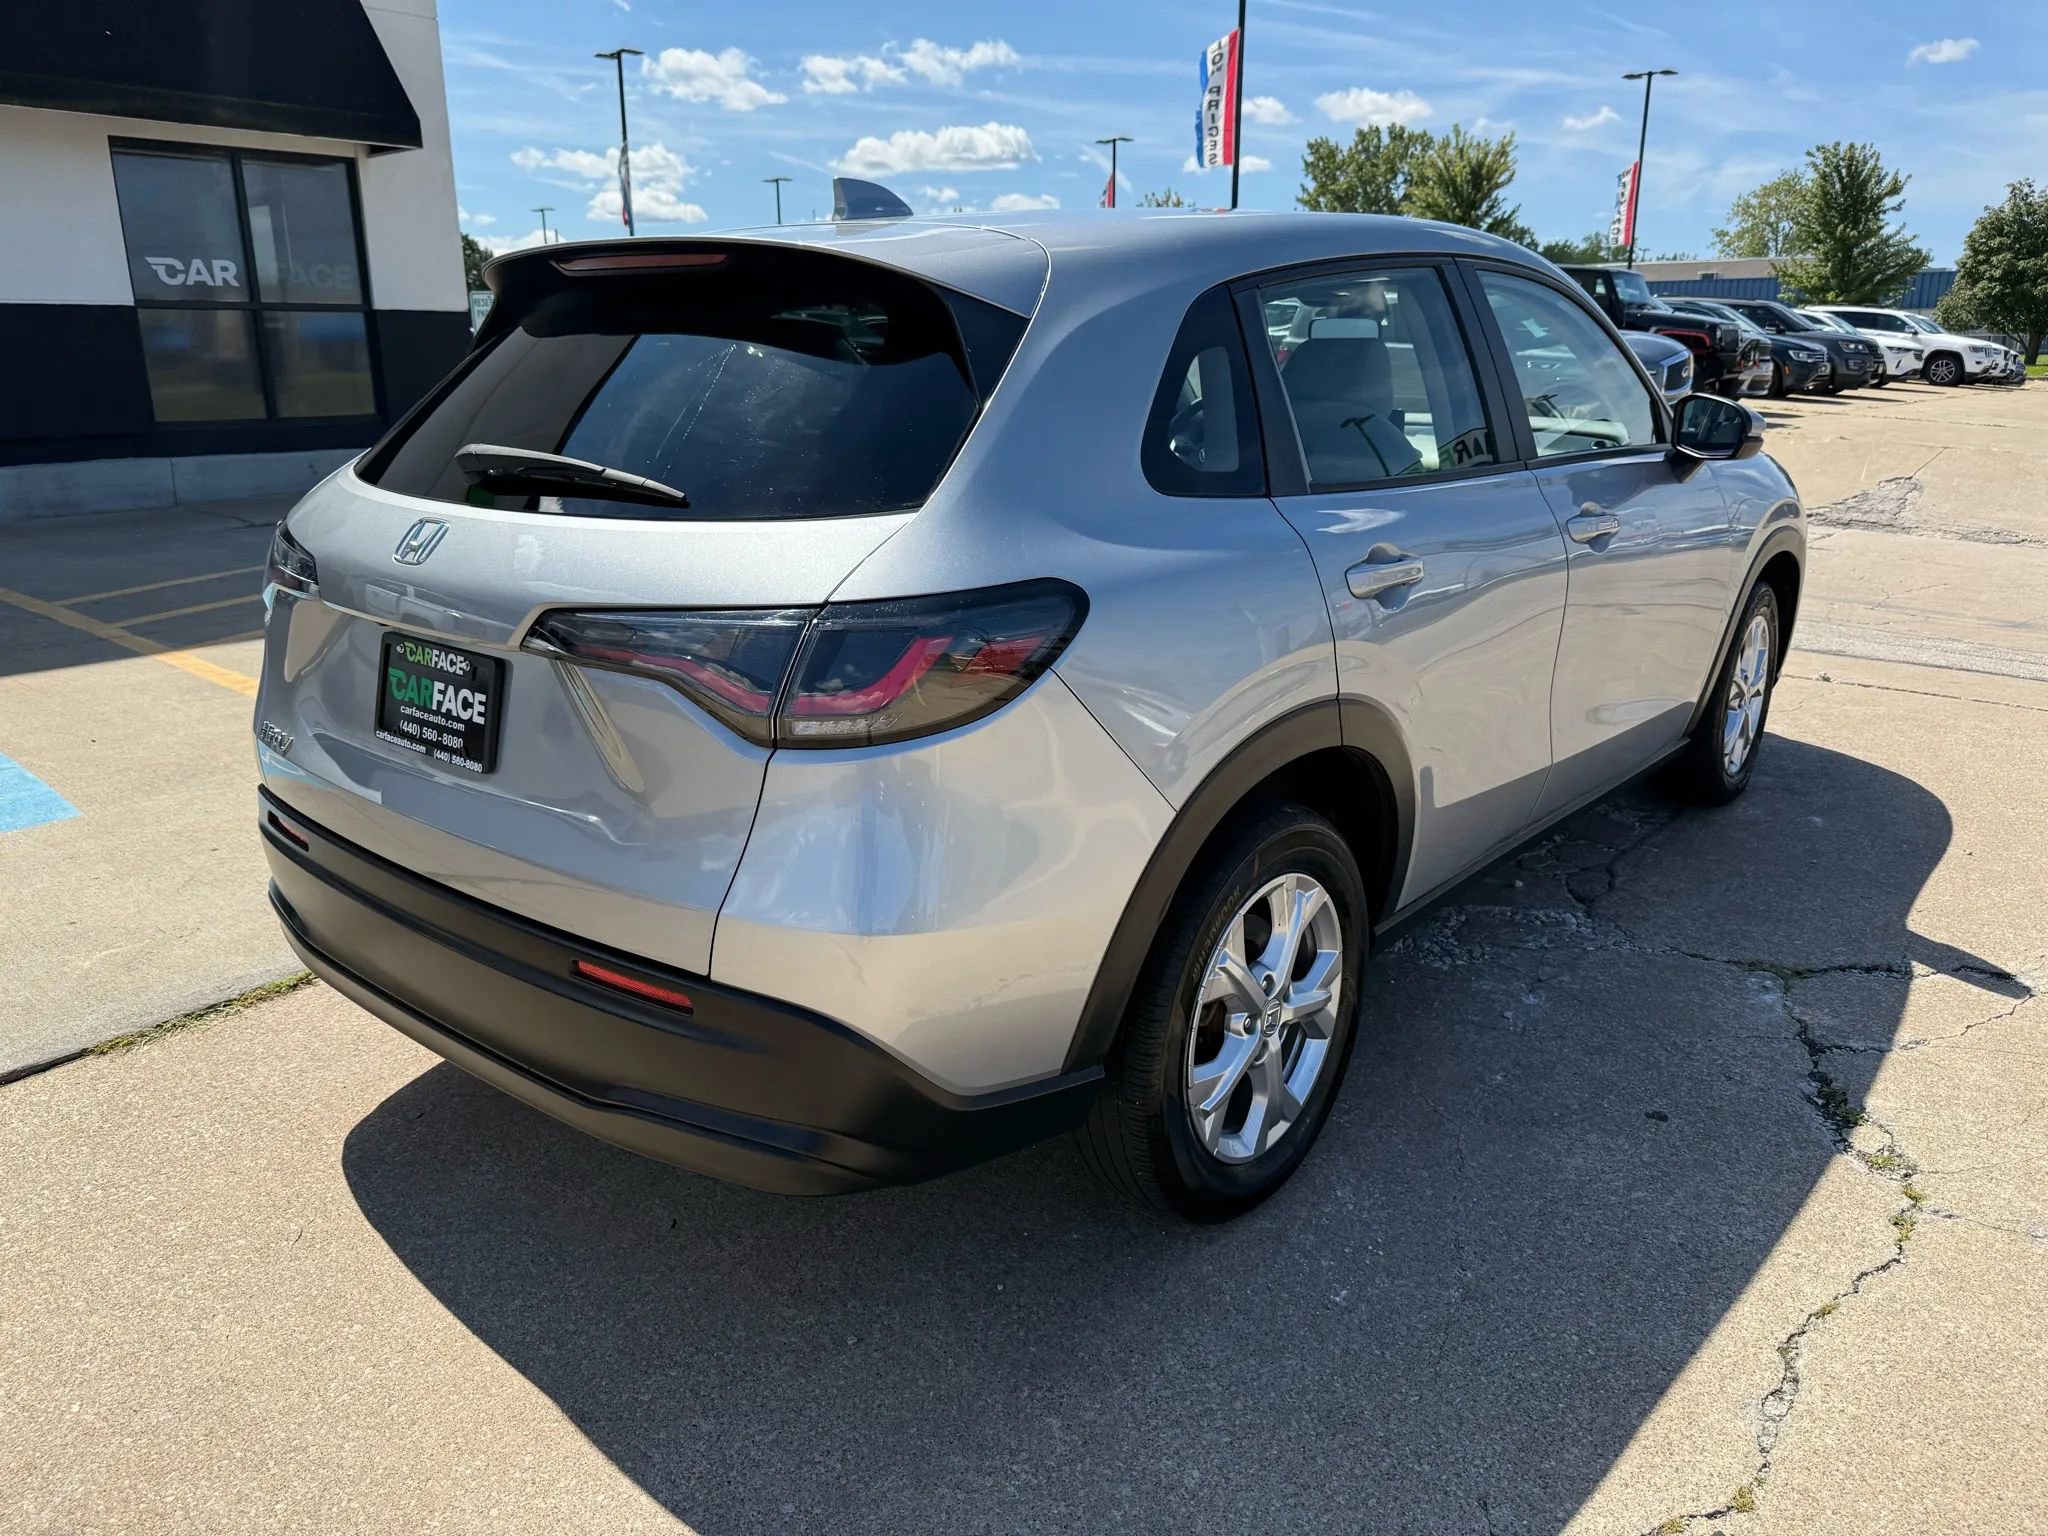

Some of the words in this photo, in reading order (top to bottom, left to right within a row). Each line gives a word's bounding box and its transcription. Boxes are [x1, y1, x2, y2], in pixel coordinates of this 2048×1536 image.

[144, 256, 240, 287] CAR
[404, 641, 465, 676] CARFACE
[388, 667, 487, 725] CARFACE
[400, 705, 465, 732] carfaceauto.com
[400, 719, 421, 739] (440)
[375, 729, 427, 754] carfaceauto.com
[433, 748, 451, 764] (440)
[451, 756, 483, 773] 560-8080
